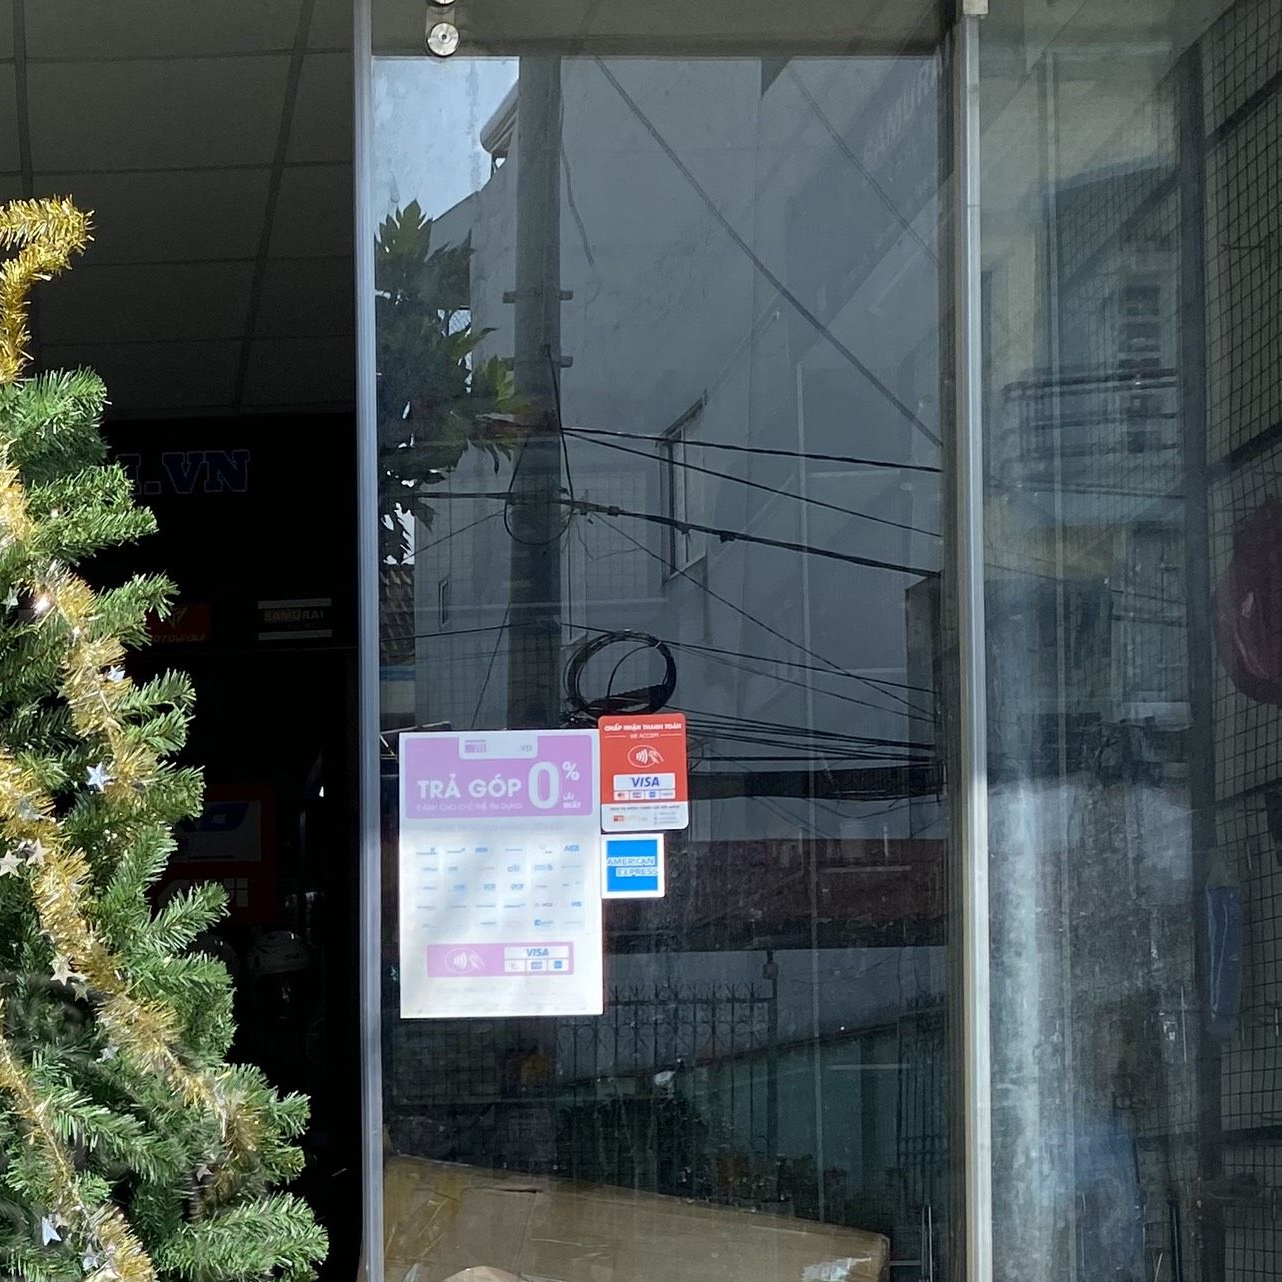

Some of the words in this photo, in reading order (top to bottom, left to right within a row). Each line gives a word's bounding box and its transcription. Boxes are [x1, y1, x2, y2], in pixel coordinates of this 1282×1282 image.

[152, 633, 206, 644] OTOWOLF
[417, 773, 461, 799] TRẢ
[469, 773, 522, 798] GÓP
[631, 777, 659, 787] VISA
[526, 948, 549, 957] VISA
